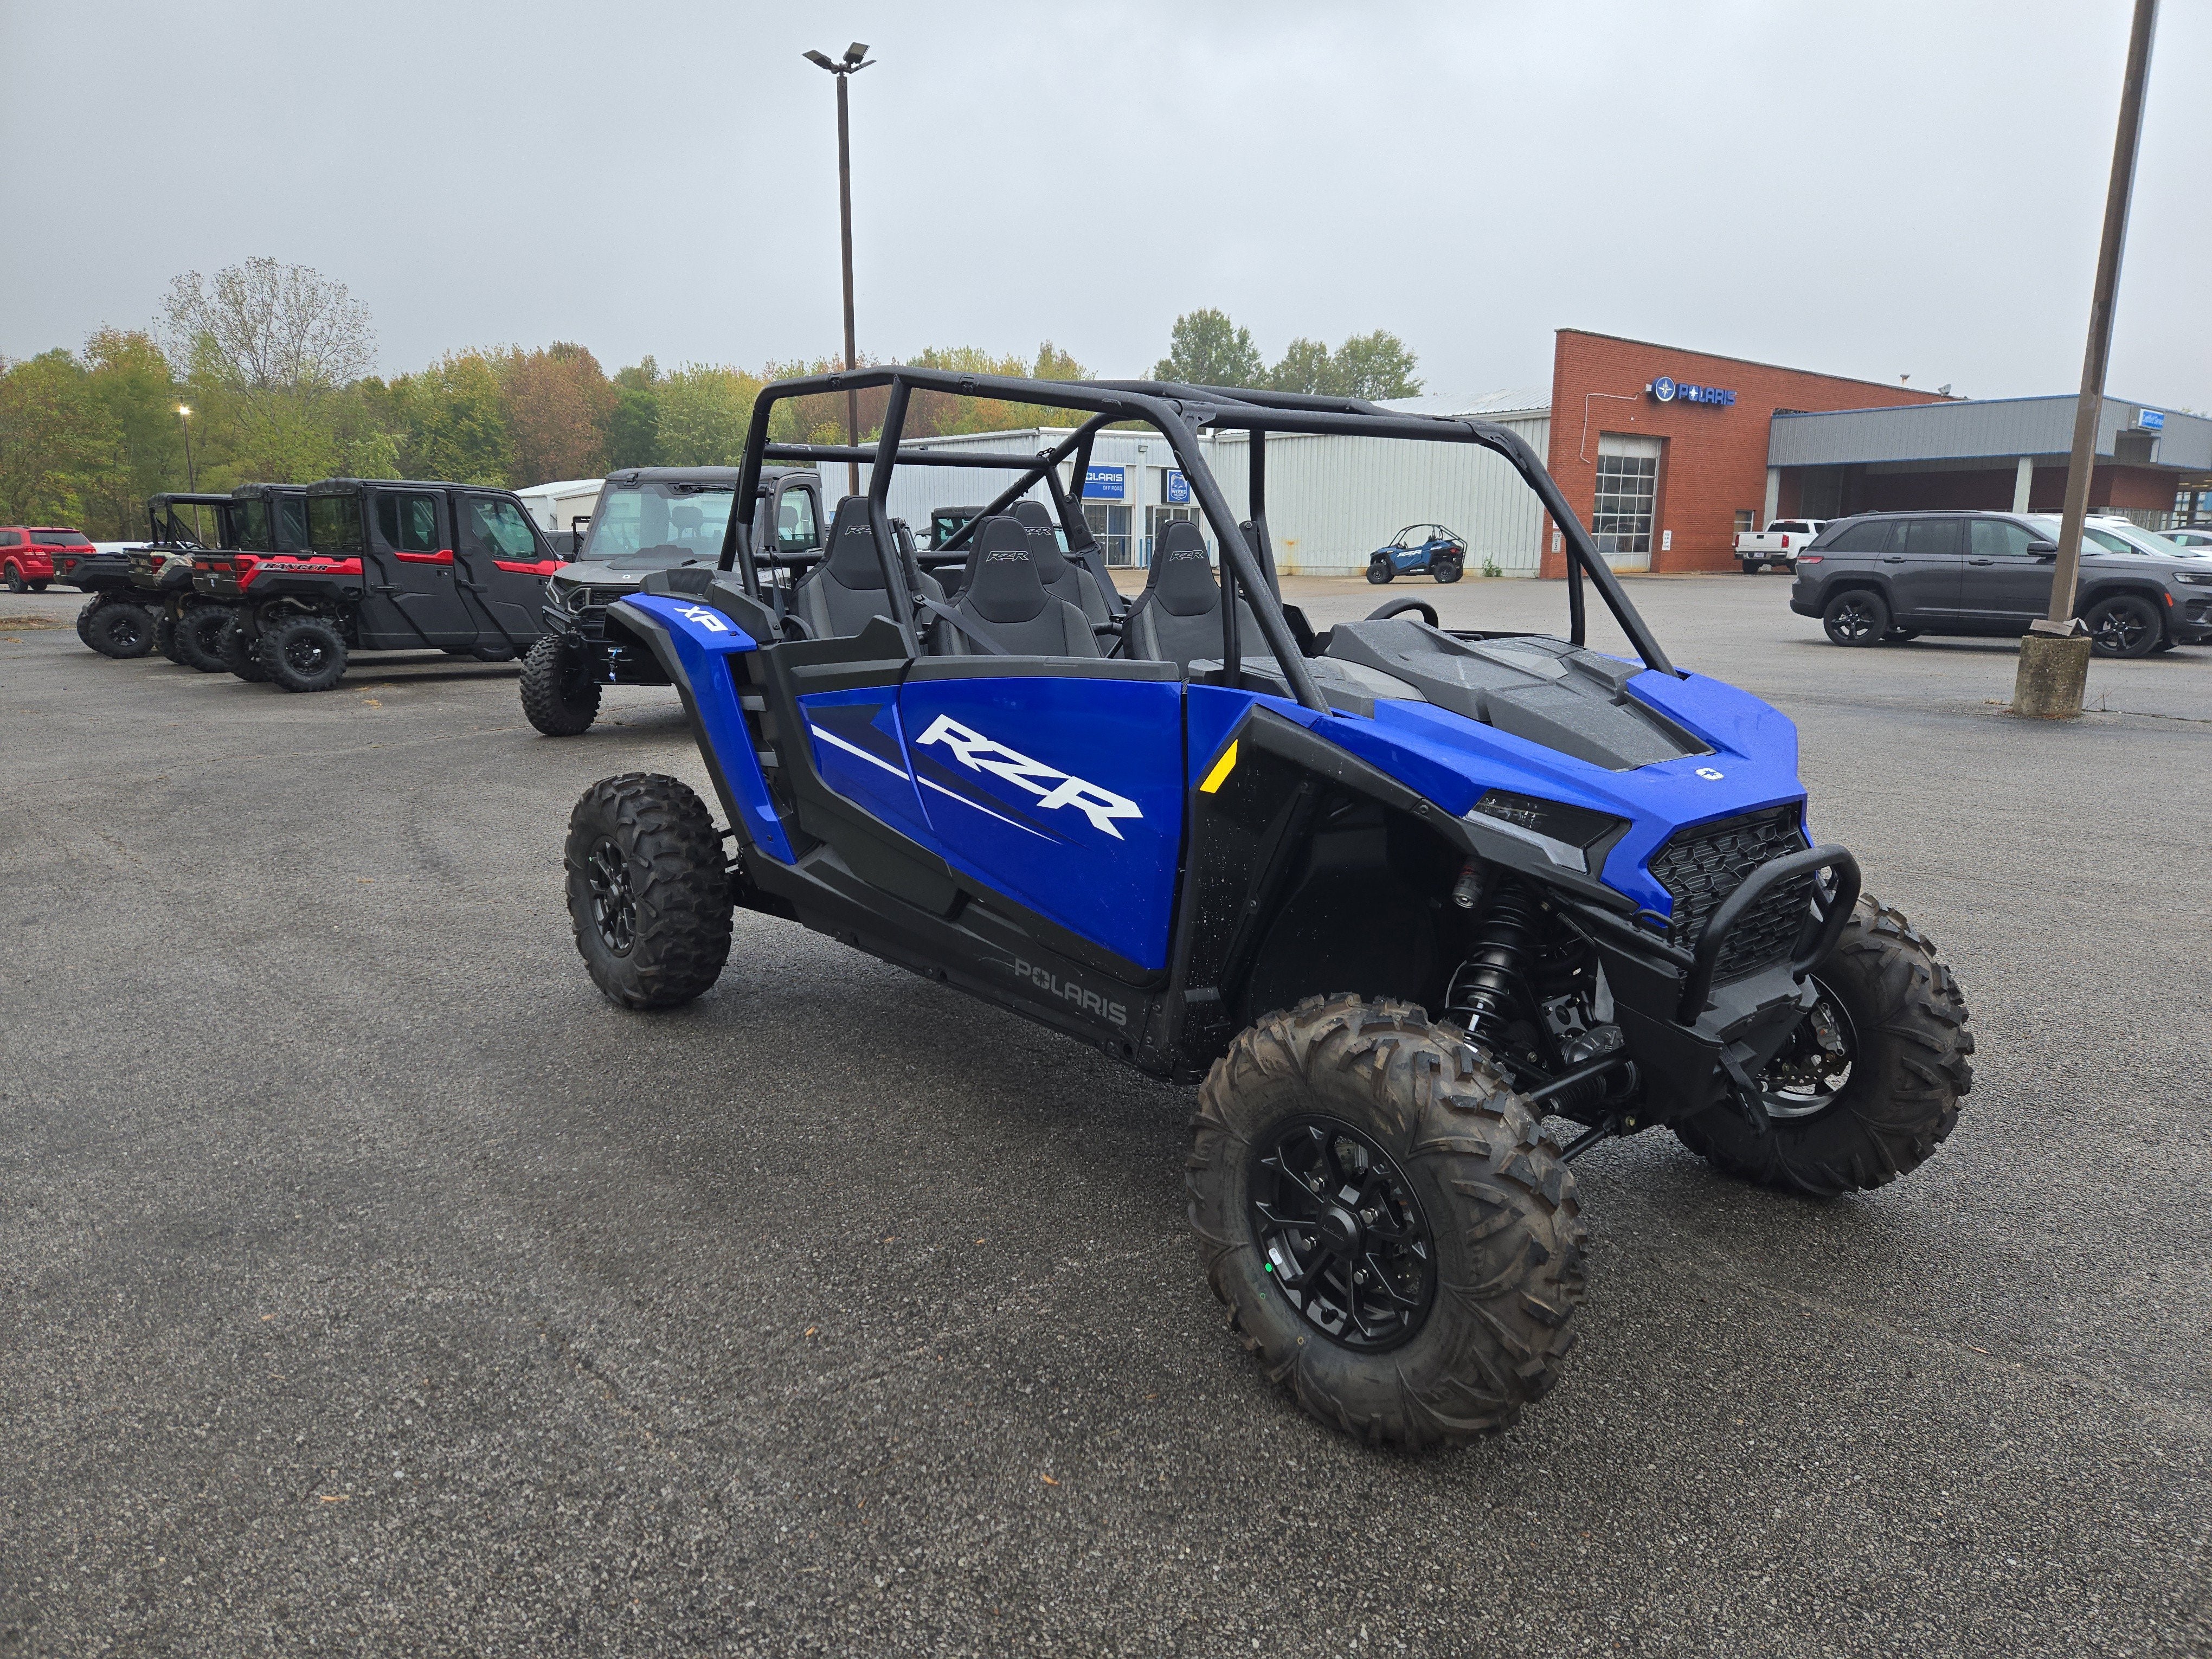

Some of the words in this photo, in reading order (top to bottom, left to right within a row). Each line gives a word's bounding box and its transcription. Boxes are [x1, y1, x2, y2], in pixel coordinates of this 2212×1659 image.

[1678, 383, 1736, 406] POLARIS
[1085, 472, 1123, 482] OLARIS
[845, 525, 872, 535] RZ
[986, 550, 1029, 562] RZR
[1169, 550, 1204, 561] RZR
[673, 606, 729, 632] XP
[915, 713, 1144, 840] RZR
[1015, 957, 1127, 1026] POLARIS
